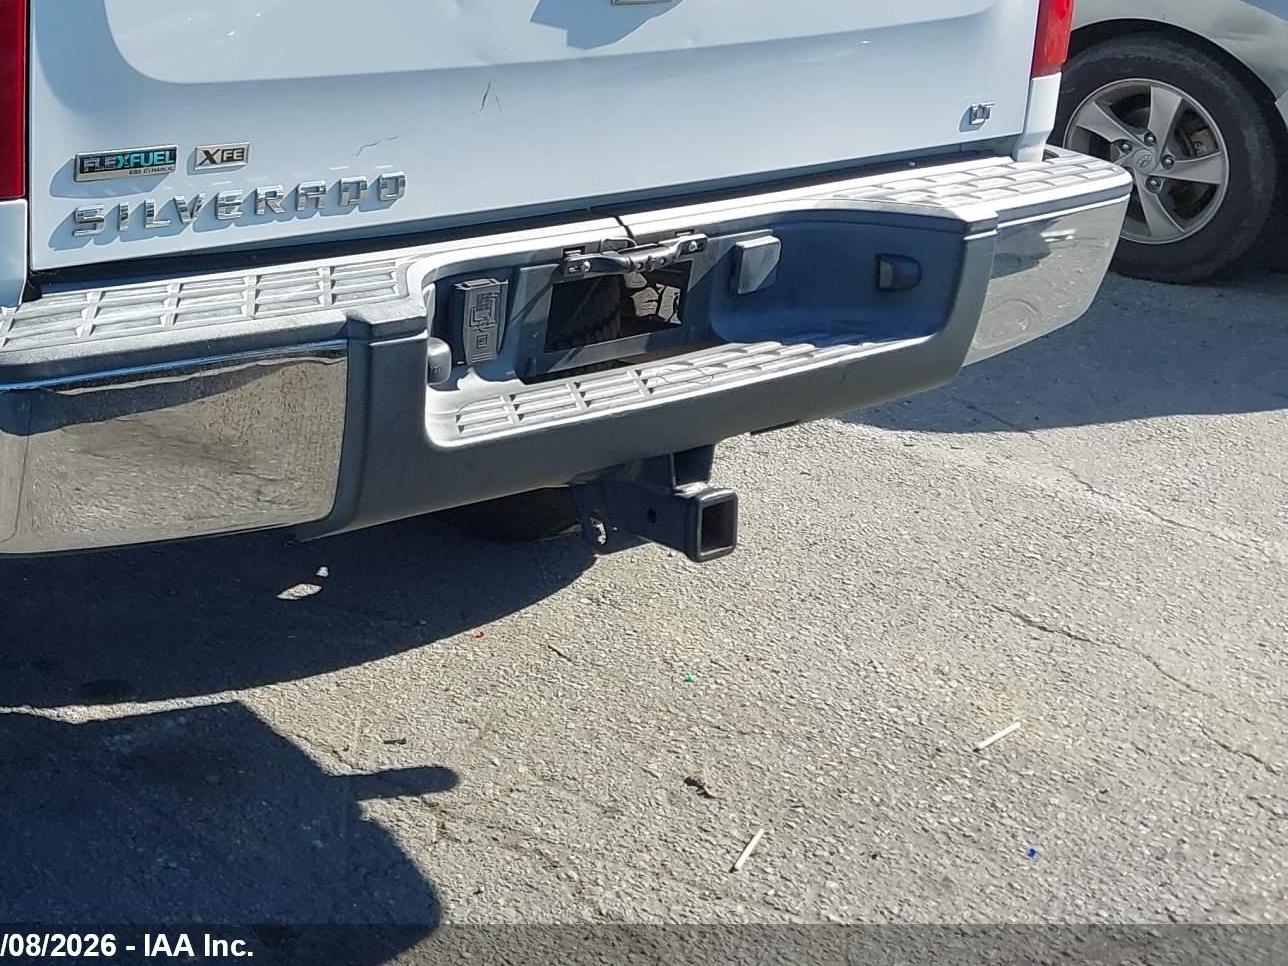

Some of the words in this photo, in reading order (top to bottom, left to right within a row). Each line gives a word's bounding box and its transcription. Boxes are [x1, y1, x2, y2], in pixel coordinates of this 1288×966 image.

[83, 150, 175, 172] FLEXFUEL
[198, 148, 244, 166] XFE
[73, 171, 407, 237] SILVERADO
